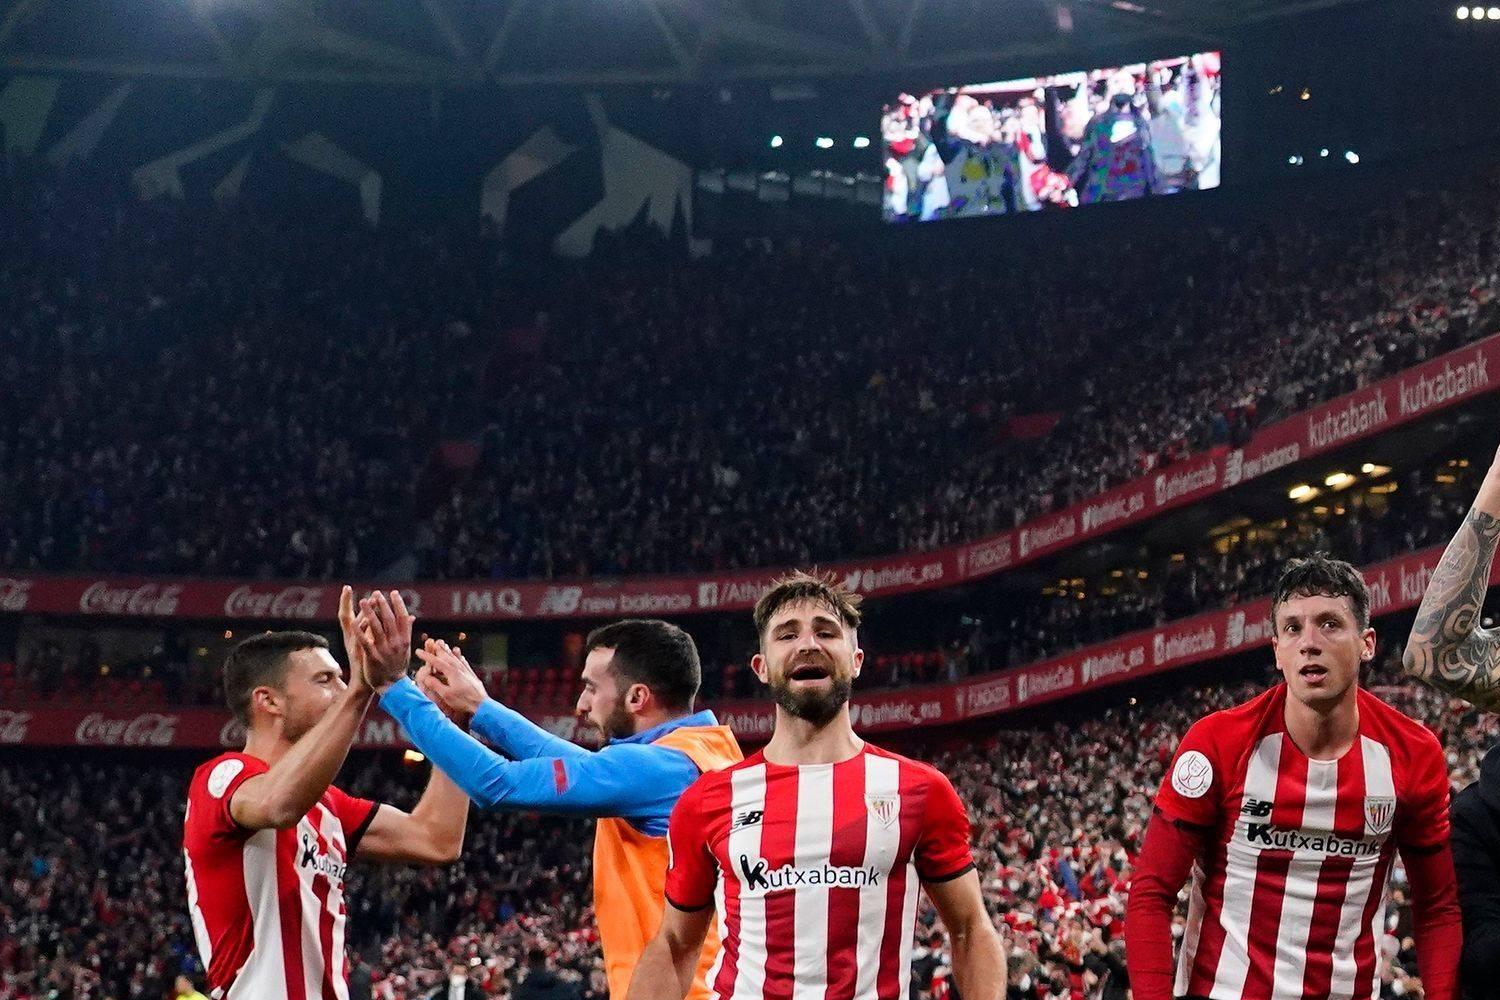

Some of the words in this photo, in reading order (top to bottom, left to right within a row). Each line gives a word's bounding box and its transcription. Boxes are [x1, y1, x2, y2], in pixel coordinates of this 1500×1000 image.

[1400, 349, 1489, 416] kutxabank
[1308, 387, 1388, 449] kutxabank
[452, 590, 523, 617] IMQ
[1246, 822, 1381, 856] Kutxabank
[739, 855, 880, 890] Kutxabank
